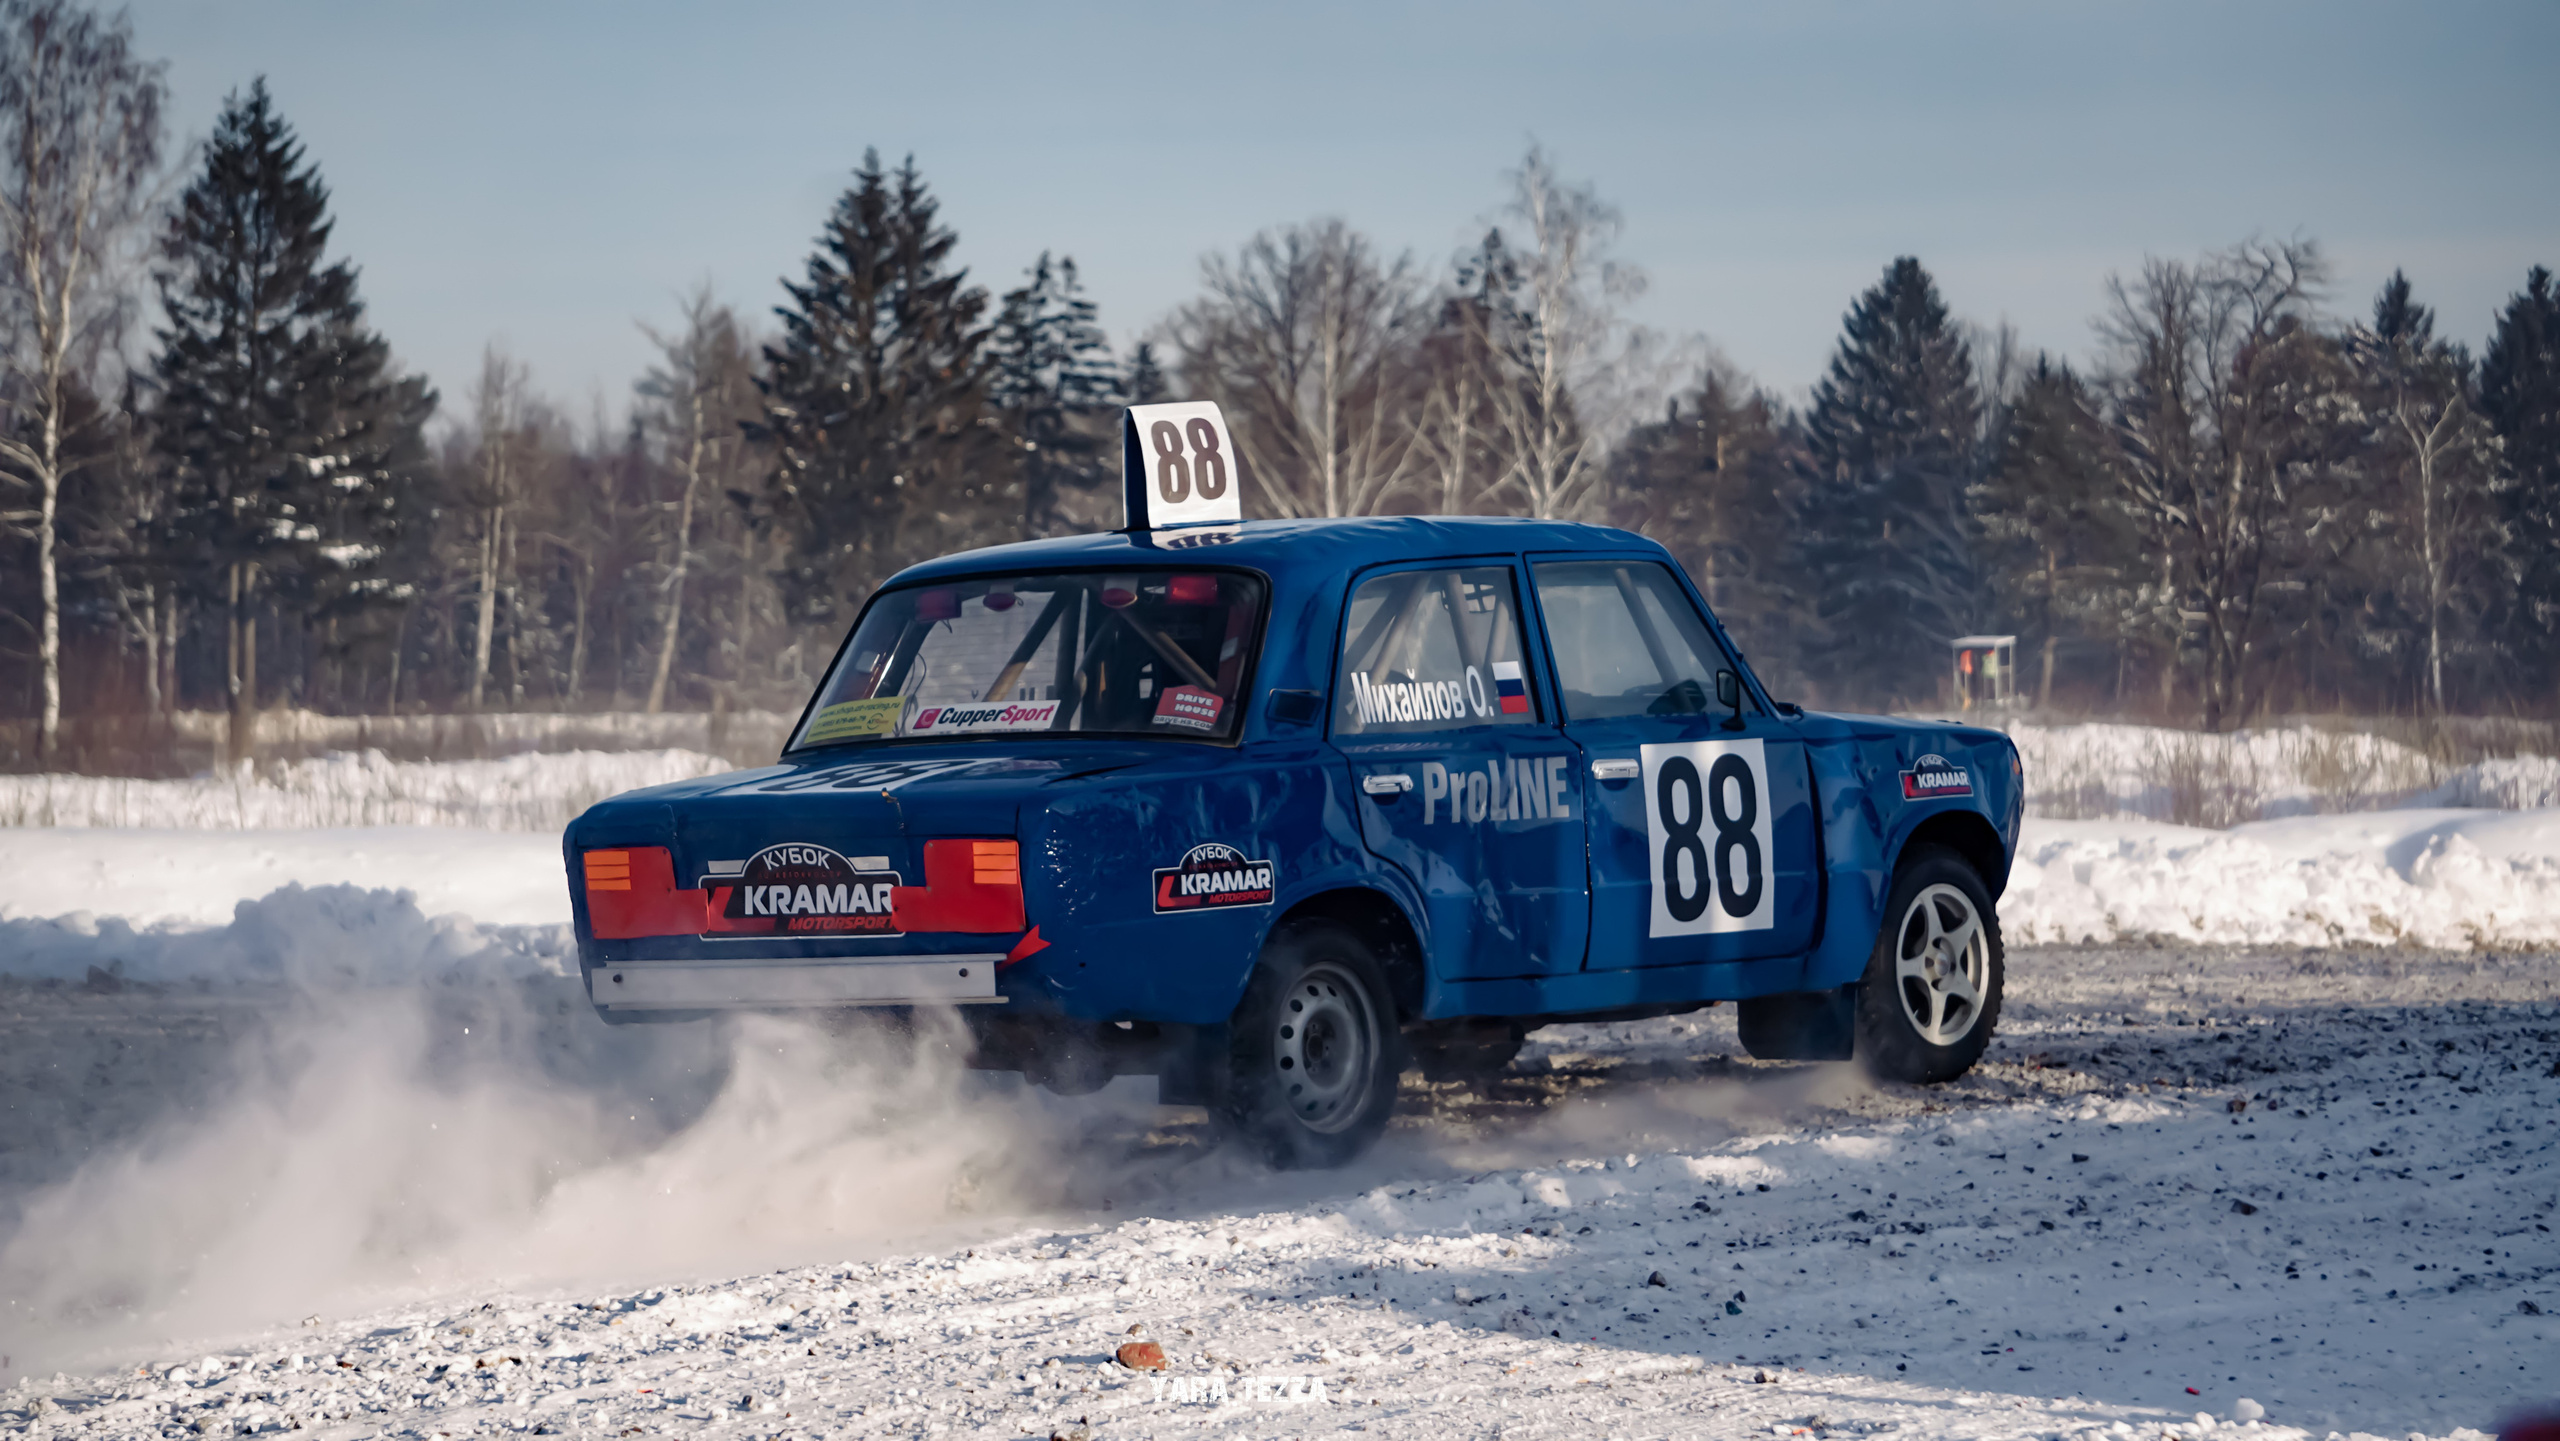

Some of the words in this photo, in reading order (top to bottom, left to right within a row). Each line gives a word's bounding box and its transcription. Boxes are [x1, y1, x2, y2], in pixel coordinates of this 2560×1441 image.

[1151, 417, 1227, 504] 88
[1175, 693, 1214, 707] DRIVE
[1351, 668, 1466, 724] Михайлов
[1466, 665, 1494, 718] О.
[938, 704, 1055, 727] CupperSport
[1174, 703, 1216, 718] HOUSE
[1422, 755, 1570, 826] ProLINE
[1917, 772, 1969, 788] KRAMAR
[1657, 753, 1763, 923] 88
[763, 848, 831, 871] КУБОК
[1192, 847, 1232, 864] КУБОК
[1181, 868, 1271, 895] KRAMAR
[744, 883, 893, 915] KRAMAR
[1208, 890, 1271, 904] MOTORSPORT
